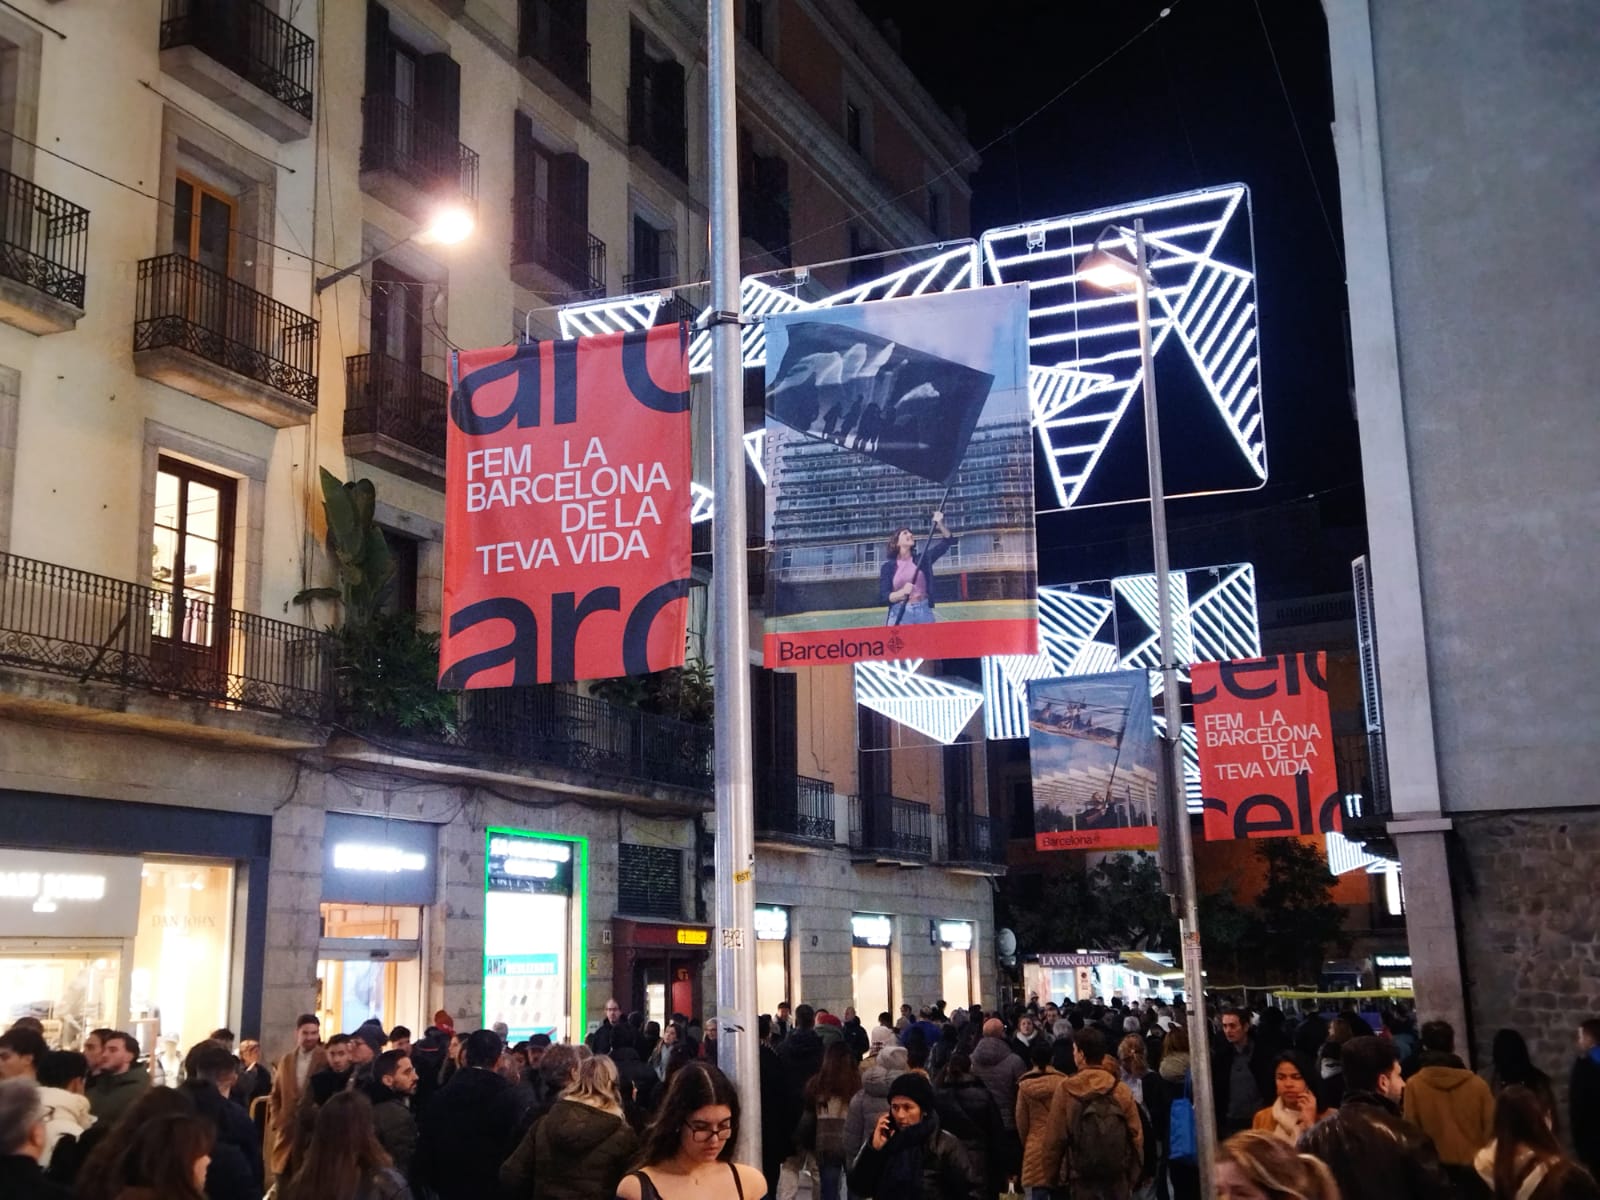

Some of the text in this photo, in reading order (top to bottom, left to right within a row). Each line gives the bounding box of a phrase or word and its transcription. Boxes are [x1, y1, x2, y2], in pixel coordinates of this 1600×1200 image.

[467, 436, 607, 481] FEM LA
[466, 461, 671, 512] BARCELONA
[561, 495, 661, 533] DE LA
[476, 529, 650, 575] TEVA VIDA
[779, 639, 884, 661] Barcelona
[1204, 709, 1285, 731] FEM LA
[1206, 723, 1321, 747] BARCELONA
[1262, 741, 1318, 761] DE LA
[1214, 759, 1313, 780] TEVA VIDA
[1042, 835, 1093, 847] Barcelona
[1042, 956, 1055, 967] LA
